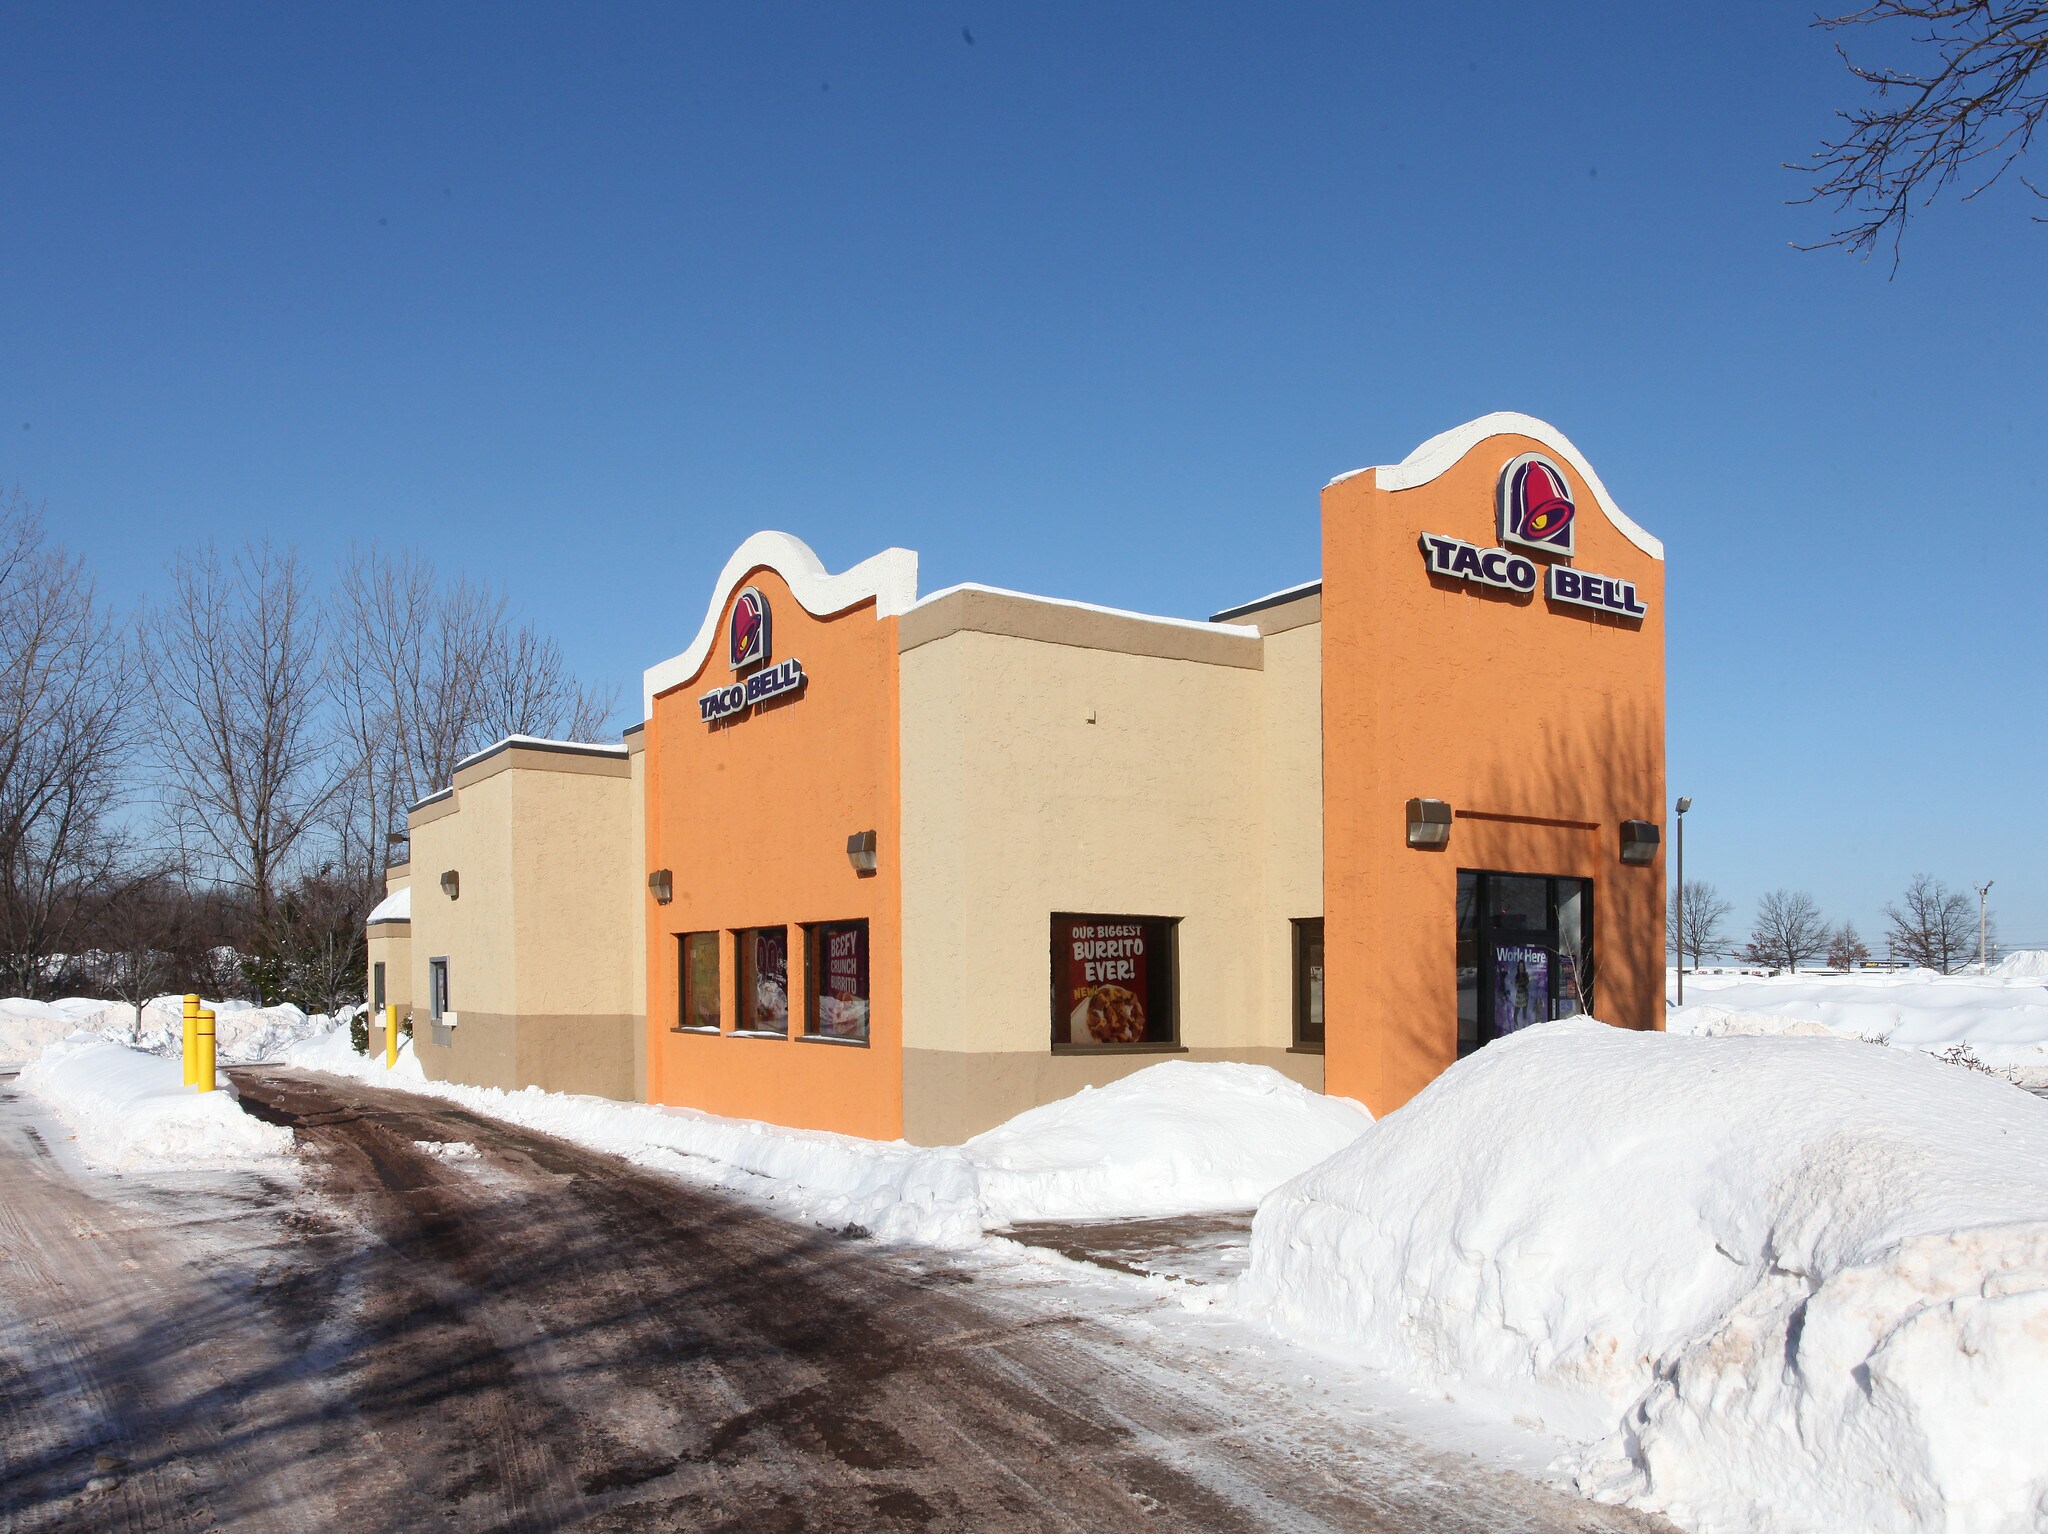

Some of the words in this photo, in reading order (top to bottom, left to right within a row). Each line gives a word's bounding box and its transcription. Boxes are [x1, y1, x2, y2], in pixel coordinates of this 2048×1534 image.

[1429, 538, 1536, 588] TACO
[1555, 569, 1645, 615] BELL
[699, 685, 744, 719] TACO
[747, 663, 797, 700] BELL
[1072, 926, 1096, 939] OUR
[1097, 925, 1143, 938] BIGGEST
[831, 930, 857, 957] BEEFY
[1072, 938, 1144, 961] BURRITO
[1496, 947, 1523, 963] Work
[1524, 949, 1547, 963] Here
[831, 958, 857, 975] CRUNCH
[1084, 958, 1136, 982] EVER!
[831, 975, 857, 995] BURRITO
[1073, 985, 1099, 1000] NEW!
